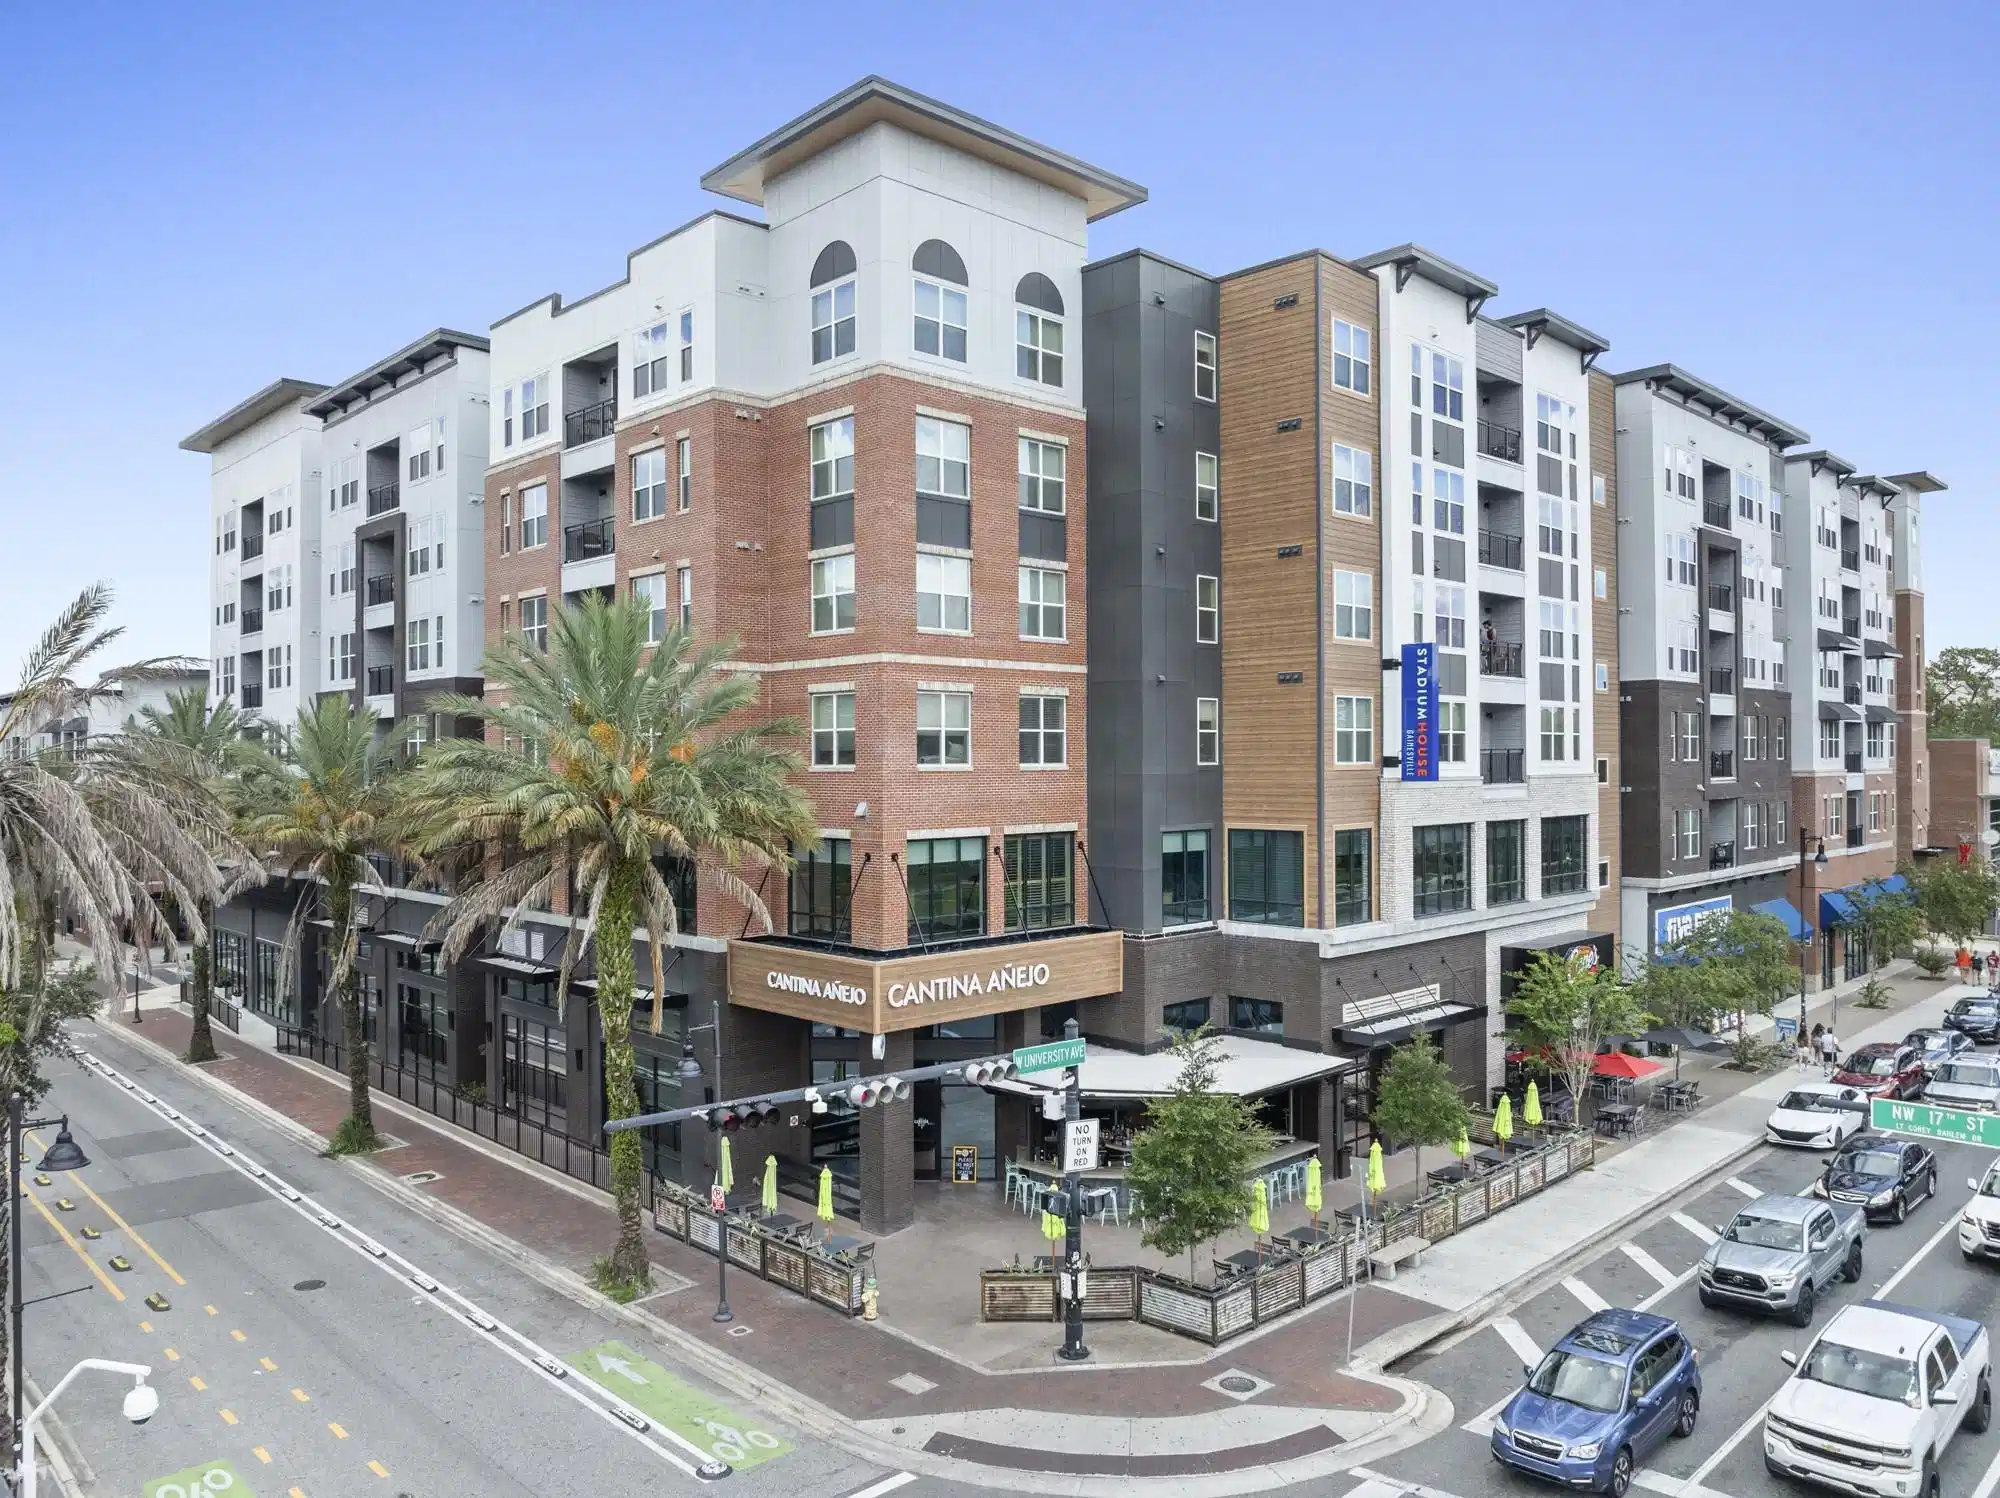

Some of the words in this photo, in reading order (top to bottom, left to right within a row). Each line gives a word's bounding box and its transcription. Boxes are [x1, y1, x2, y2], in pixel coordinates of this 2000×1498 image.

[1406, 729, 1415, 777] GAINESVILLE
[767, 971, 821, 998] CANTINA
[822, 980, 867, 1006] AÑEJO
[887, 973, 984, 1008] CANTINA
[986, 963, 1050, 993] AÑEJO
[1024, 1047, 1071, 1068] UNIVERSITY
[1070, 1044, 1085, 1060] AVE
[1892, 1104, 1915, 1122] NW
[1966, 1117, 1986, 1132] ST
[1076, 1124, 1090, 1135] NO
[1908, 1125, 1931, 1134] COREY
[1972, 1135, 1982, 1143] DR
[1073, 1136, 1092, 1146] TURN
[1076, 1147, 1087, 1156] ON
[1073, 1157, 1088, 1167] RED
